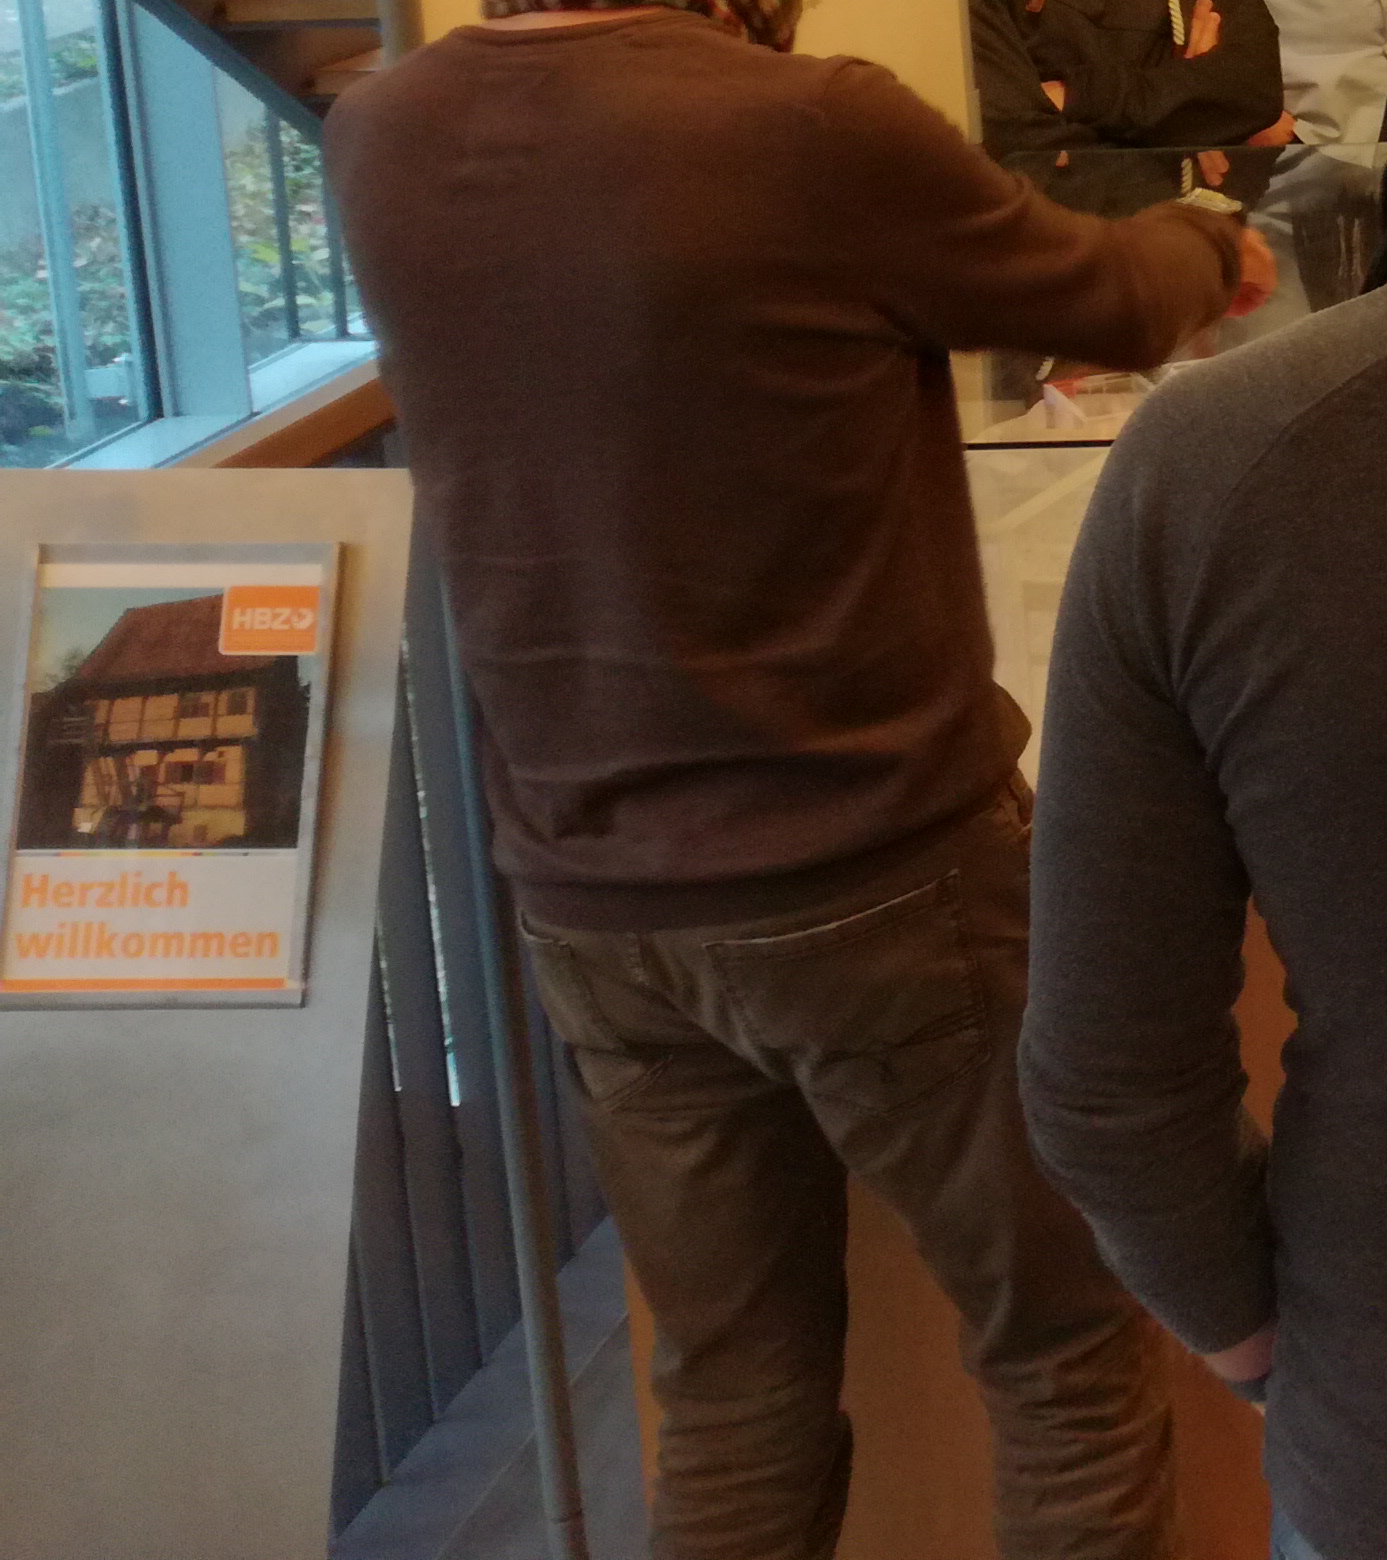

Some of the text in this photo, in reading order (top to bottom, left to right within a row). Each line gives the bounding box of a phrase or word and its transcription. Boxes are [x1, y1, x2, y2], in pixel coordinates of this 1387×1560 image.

[232, 607, 291, 630] HBZ
[19, 871, 189, 908] Herzlich
[16, 921, 281, 960] willkommen
